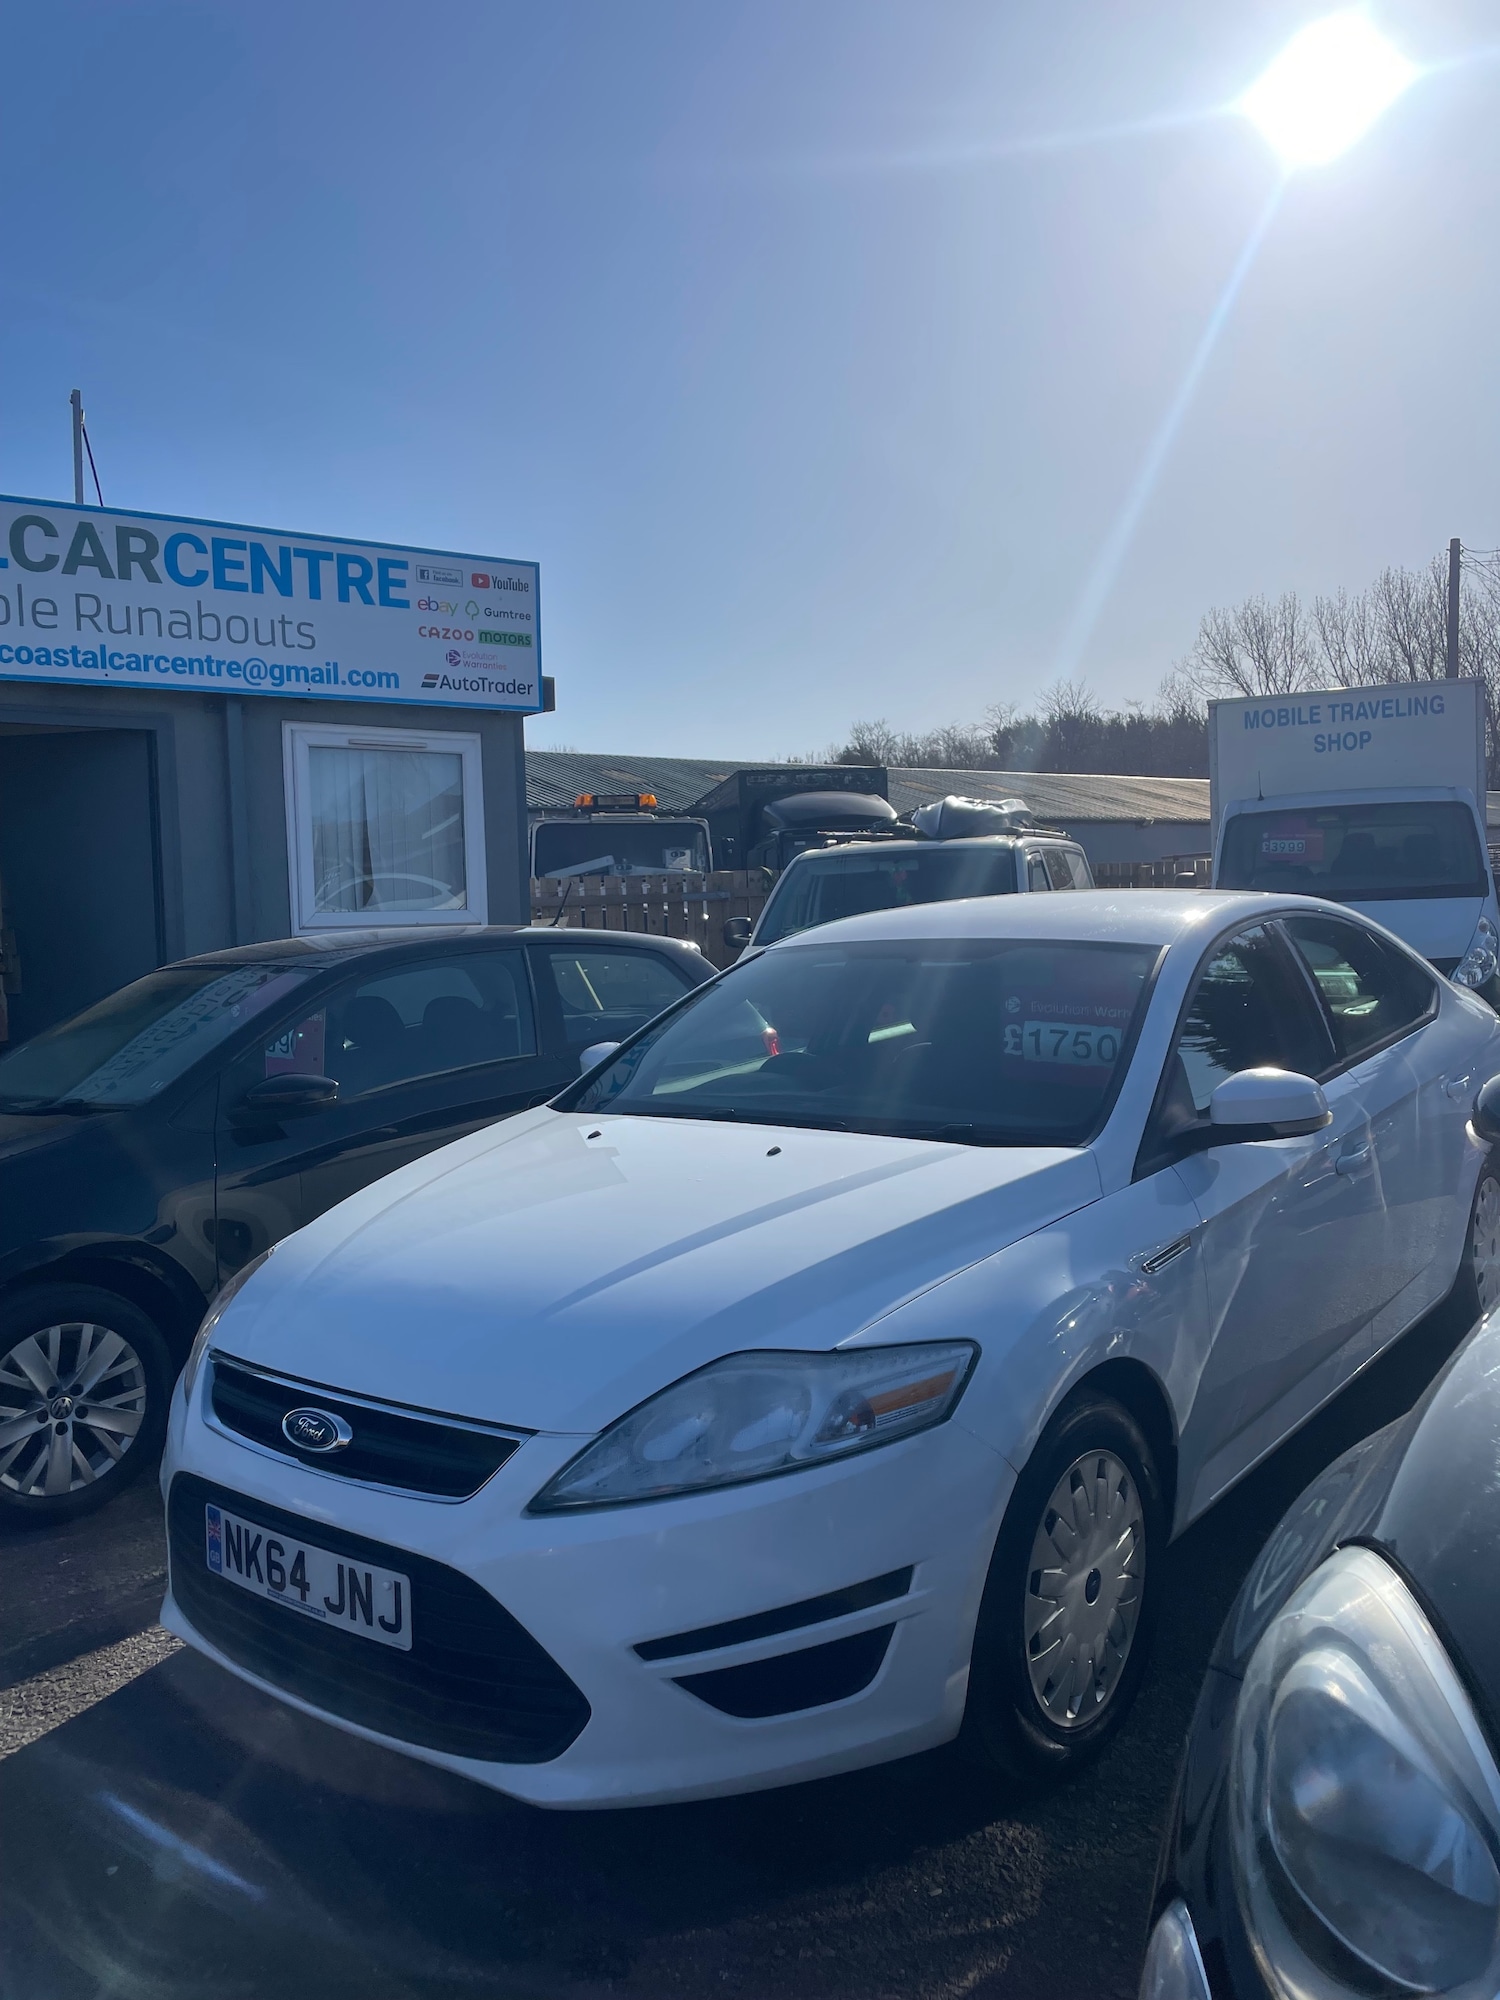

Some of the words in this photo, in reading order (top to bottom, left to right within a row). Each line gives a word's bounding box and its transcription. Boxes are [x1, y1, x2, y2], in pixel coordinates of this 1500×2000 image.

[491, 575, 529, 592] YouTube
[417, 596, 458, 616] ebay
[484, 607, 532, 621] Gumtree
[75, 592, 317, 650] Runabouts
[0, 643, 400, 689] coastalcarcentre@gmail.com
[462, 650, 498, 661] Evolution
[462, 660, 507, 671] Warranties
[439, 674, 533, 695] AutoTrader
[1243, 704, 1322, 730] MOBILE
[1327, 694, 1446, 722] TRAVELING
[1313, 730, 1373, 753] SHOP
[1003, 1023, 1118, 1063] £1750
[293, 1416, 326, 1442] Ford
[224, 1518, 310, 1603] NK64
[323, 1563, 402, 1635] JNJ
